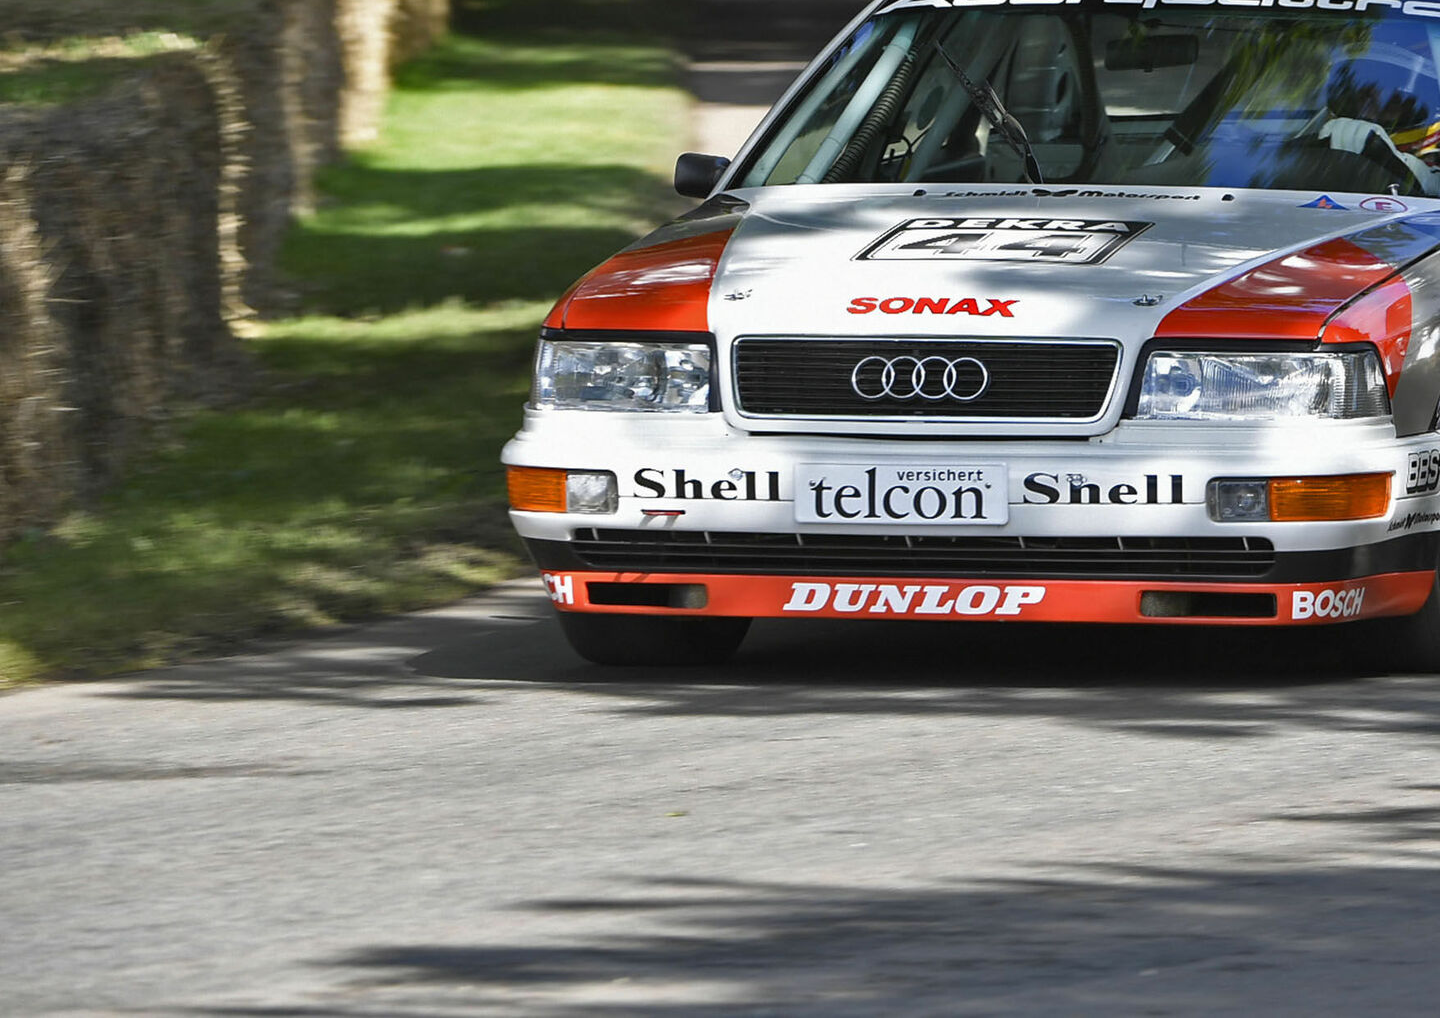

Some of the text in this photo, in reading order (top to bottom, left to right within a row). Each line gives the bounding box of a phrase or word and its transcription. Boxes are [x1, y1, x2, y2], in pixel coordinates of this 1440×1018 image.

[1077, 189, 1201, 201] Motorsport
[905, 217, 1131, 232] DEKRA
[894, 232, 1093, 258] 44
[847, 296, 1020, 318] SONAX
[633, 467, 780, 501] Shell
[896, 468, 984, 482] versichert
[1023, 472, 1184, 505] Shell
[810, 466, 988, 520] telcon
[782, 581, 1046, 615] DUNLOP
[1292, 587, 1365, 620] BOSCH
